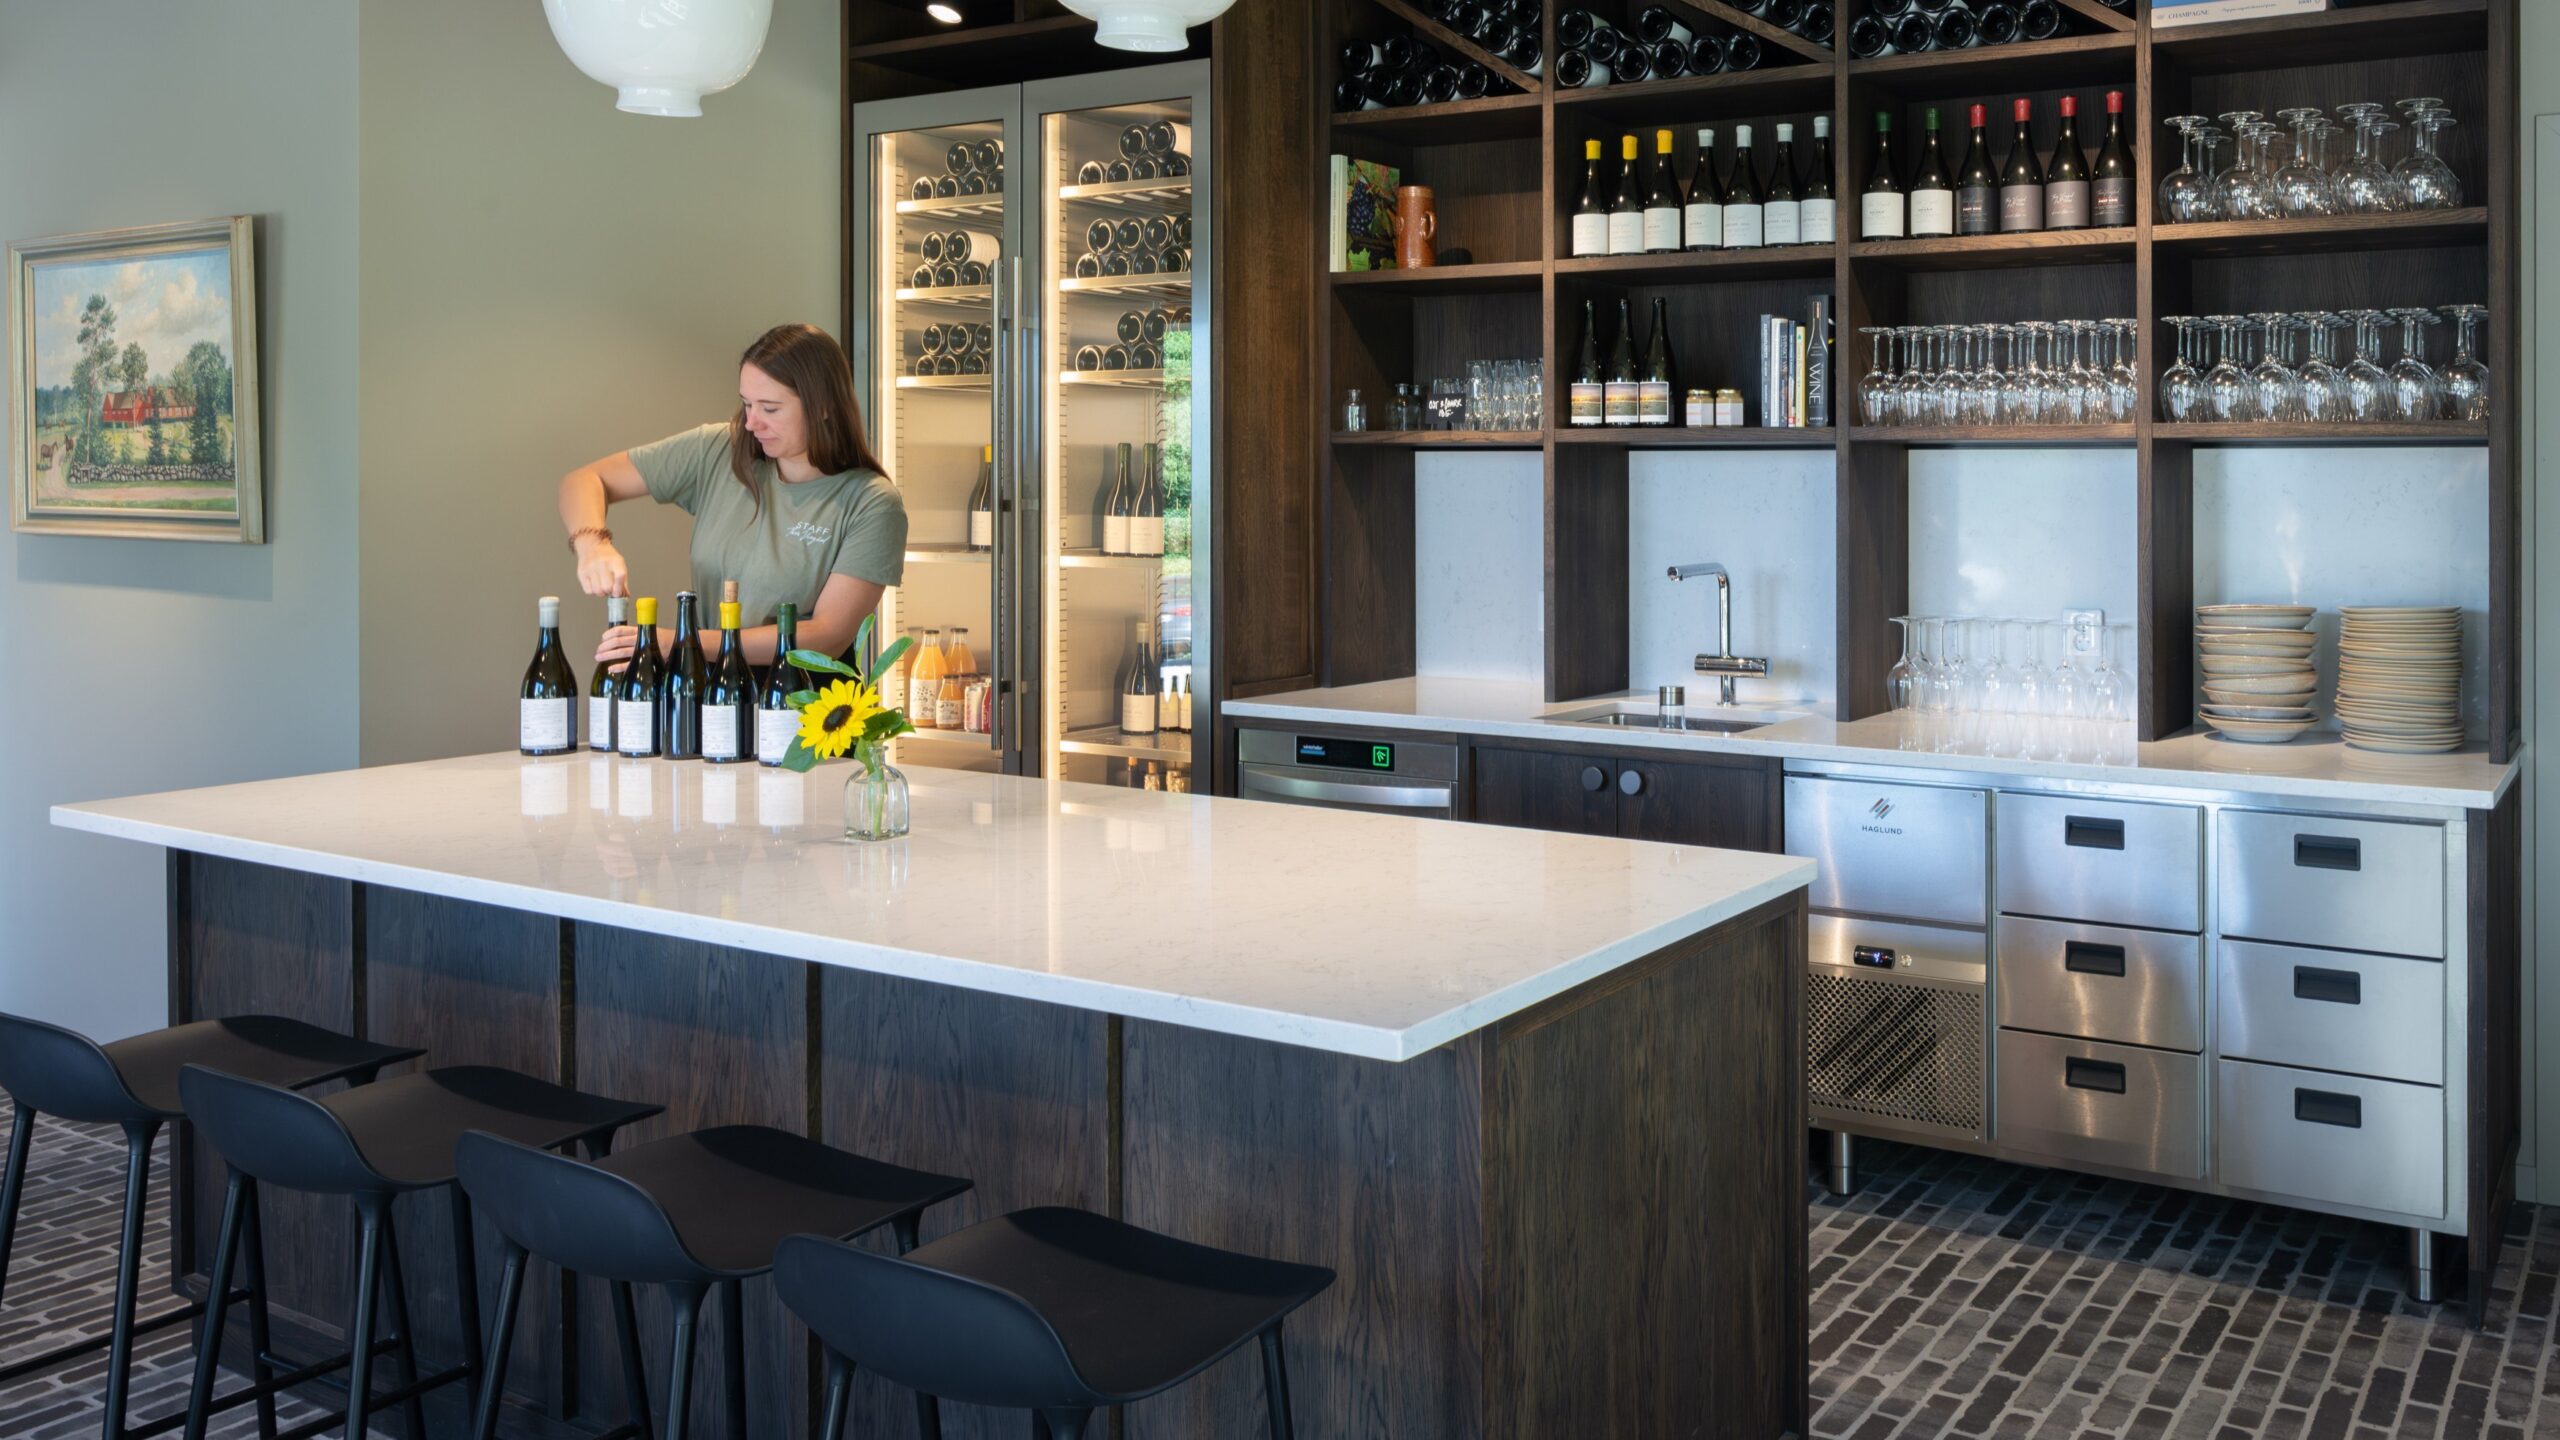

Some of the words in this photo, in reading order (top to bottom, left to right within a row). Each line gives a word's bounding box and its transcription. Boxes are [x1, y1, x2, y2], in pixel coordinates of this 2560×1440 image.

[2168, 9, 2209, 19] CHAMPAGNE
[1809, 362, 1821, 405] WINE
[796, 521, 831, 535] STAFF
[1861, 825, 1903, 835] HAGLUND
